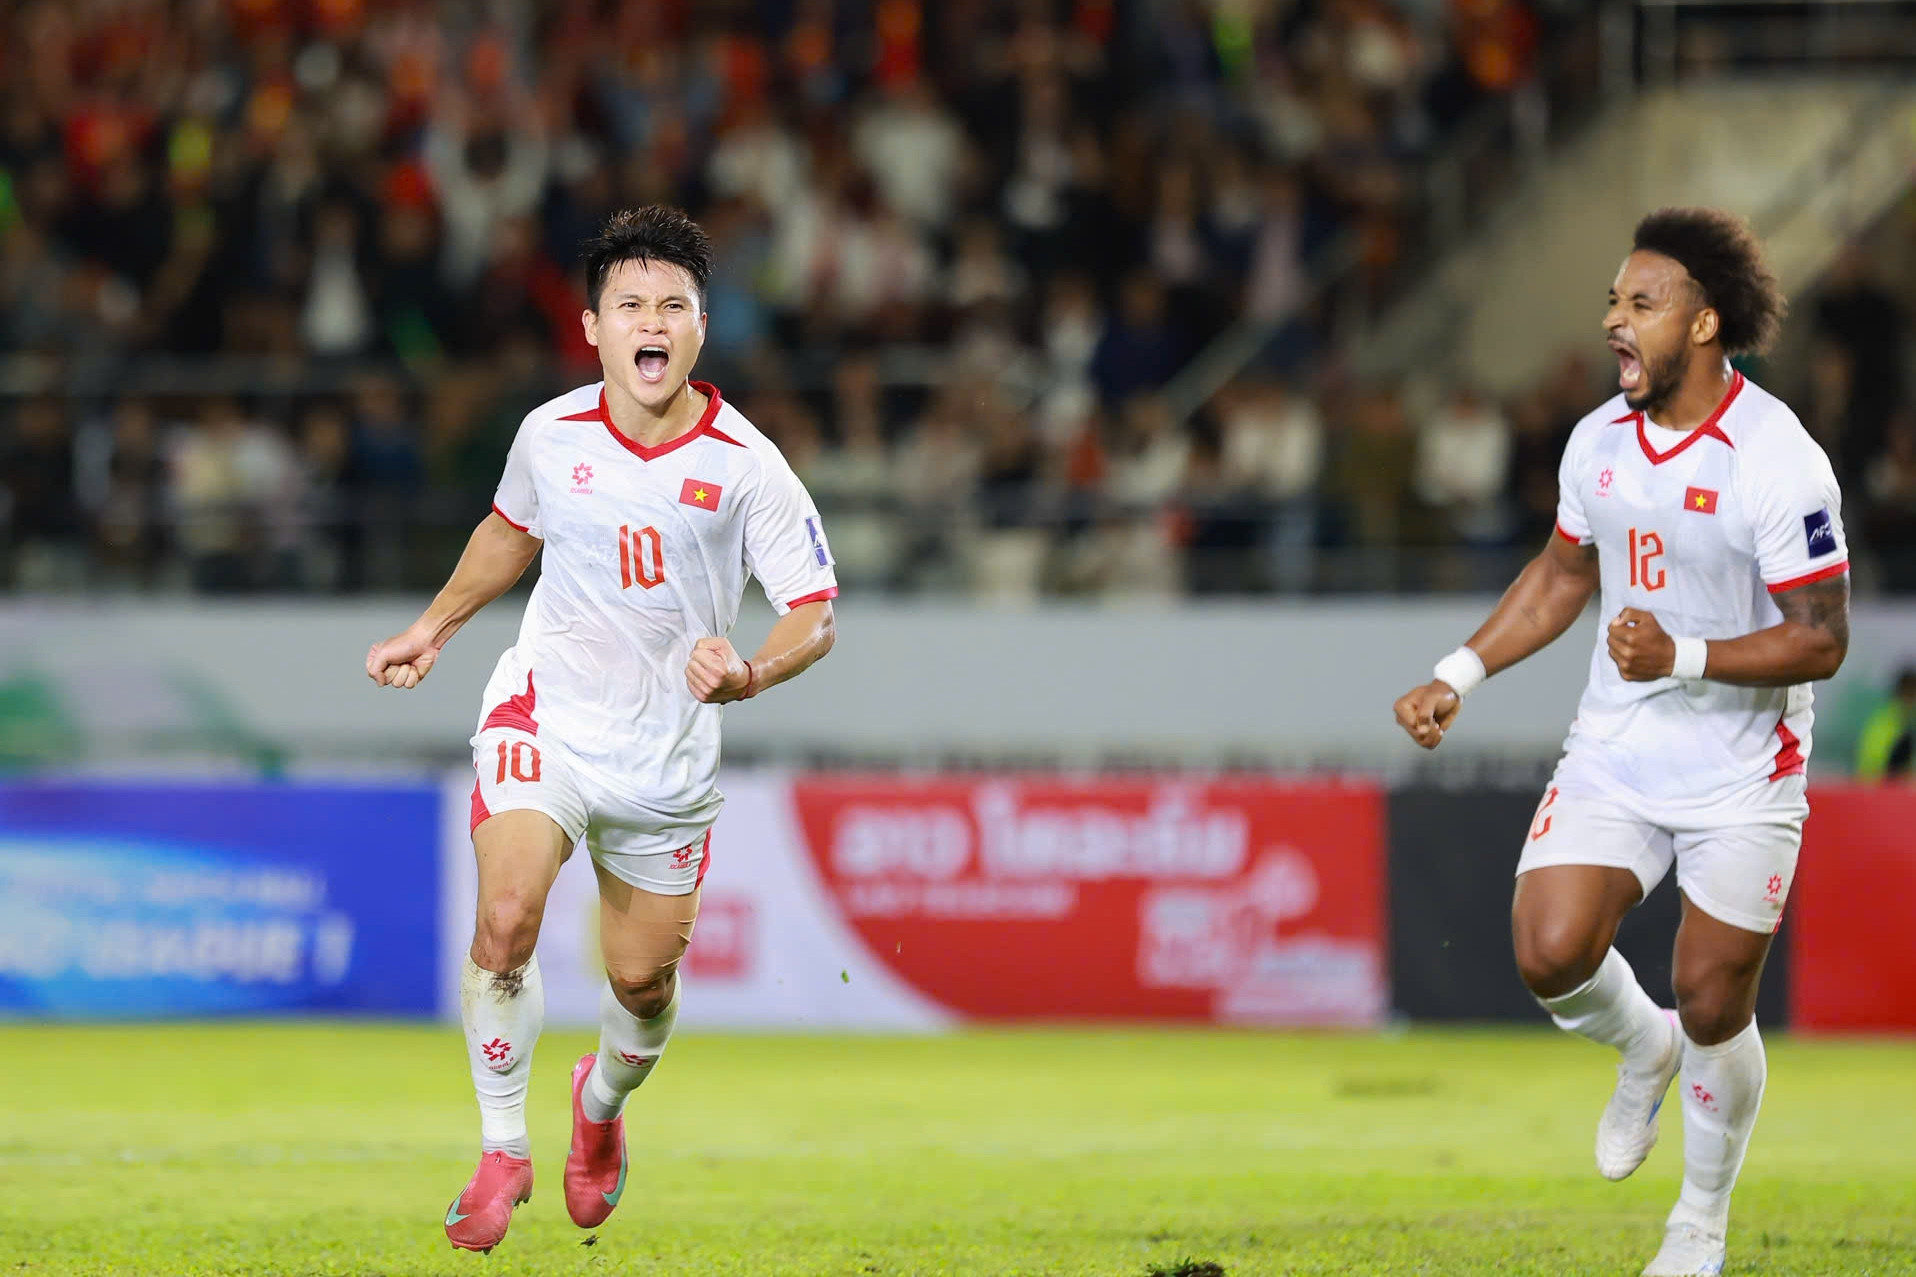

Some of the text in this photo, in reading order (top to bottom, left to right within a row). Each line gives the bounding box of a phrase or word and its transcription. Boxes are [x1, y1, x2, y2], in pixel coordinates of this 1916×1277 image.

[618, 524, 666, 590] 10
[1628, 527, 1665, 592] 12
[1809, 521, 1832, 545] AFC
[495, 740, 542, 785] 10
[1531, 786, 1558, 841] 2
